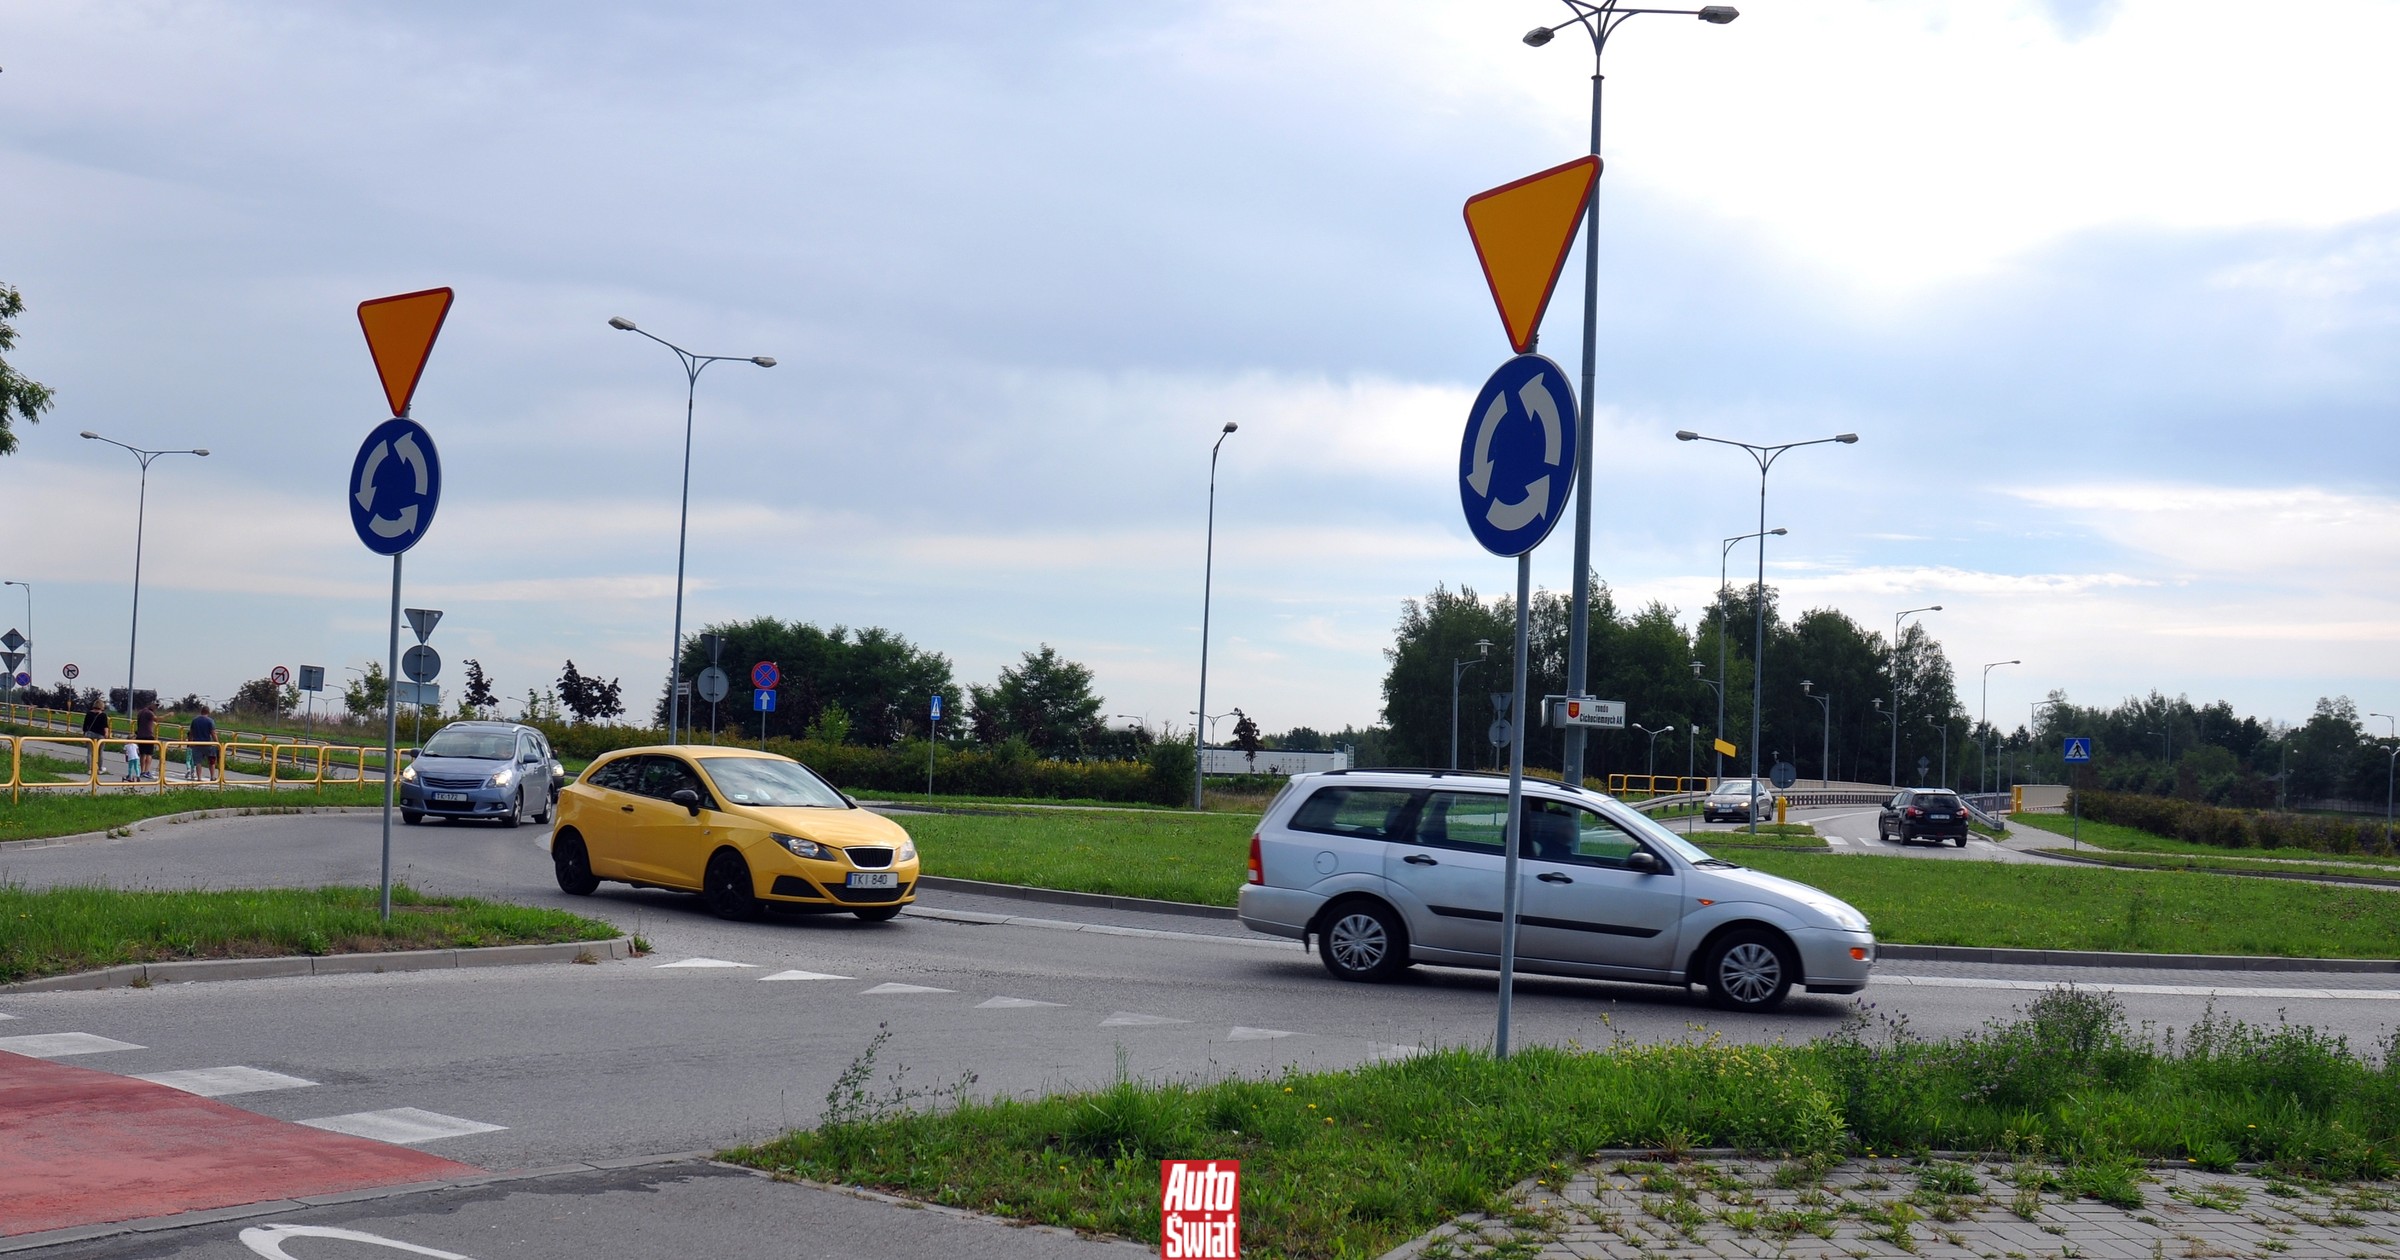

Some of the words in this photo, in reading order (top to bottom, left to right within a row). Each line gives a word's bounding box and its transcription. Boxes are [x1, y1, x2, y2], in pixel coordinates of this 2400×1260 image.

[1595, 704, 1609, 713] rondo
[1580, 713, 1616, 725] Cichociemnych
[1616, 715, 1623, 725] AK
[871, 874, 887, 885] 840
